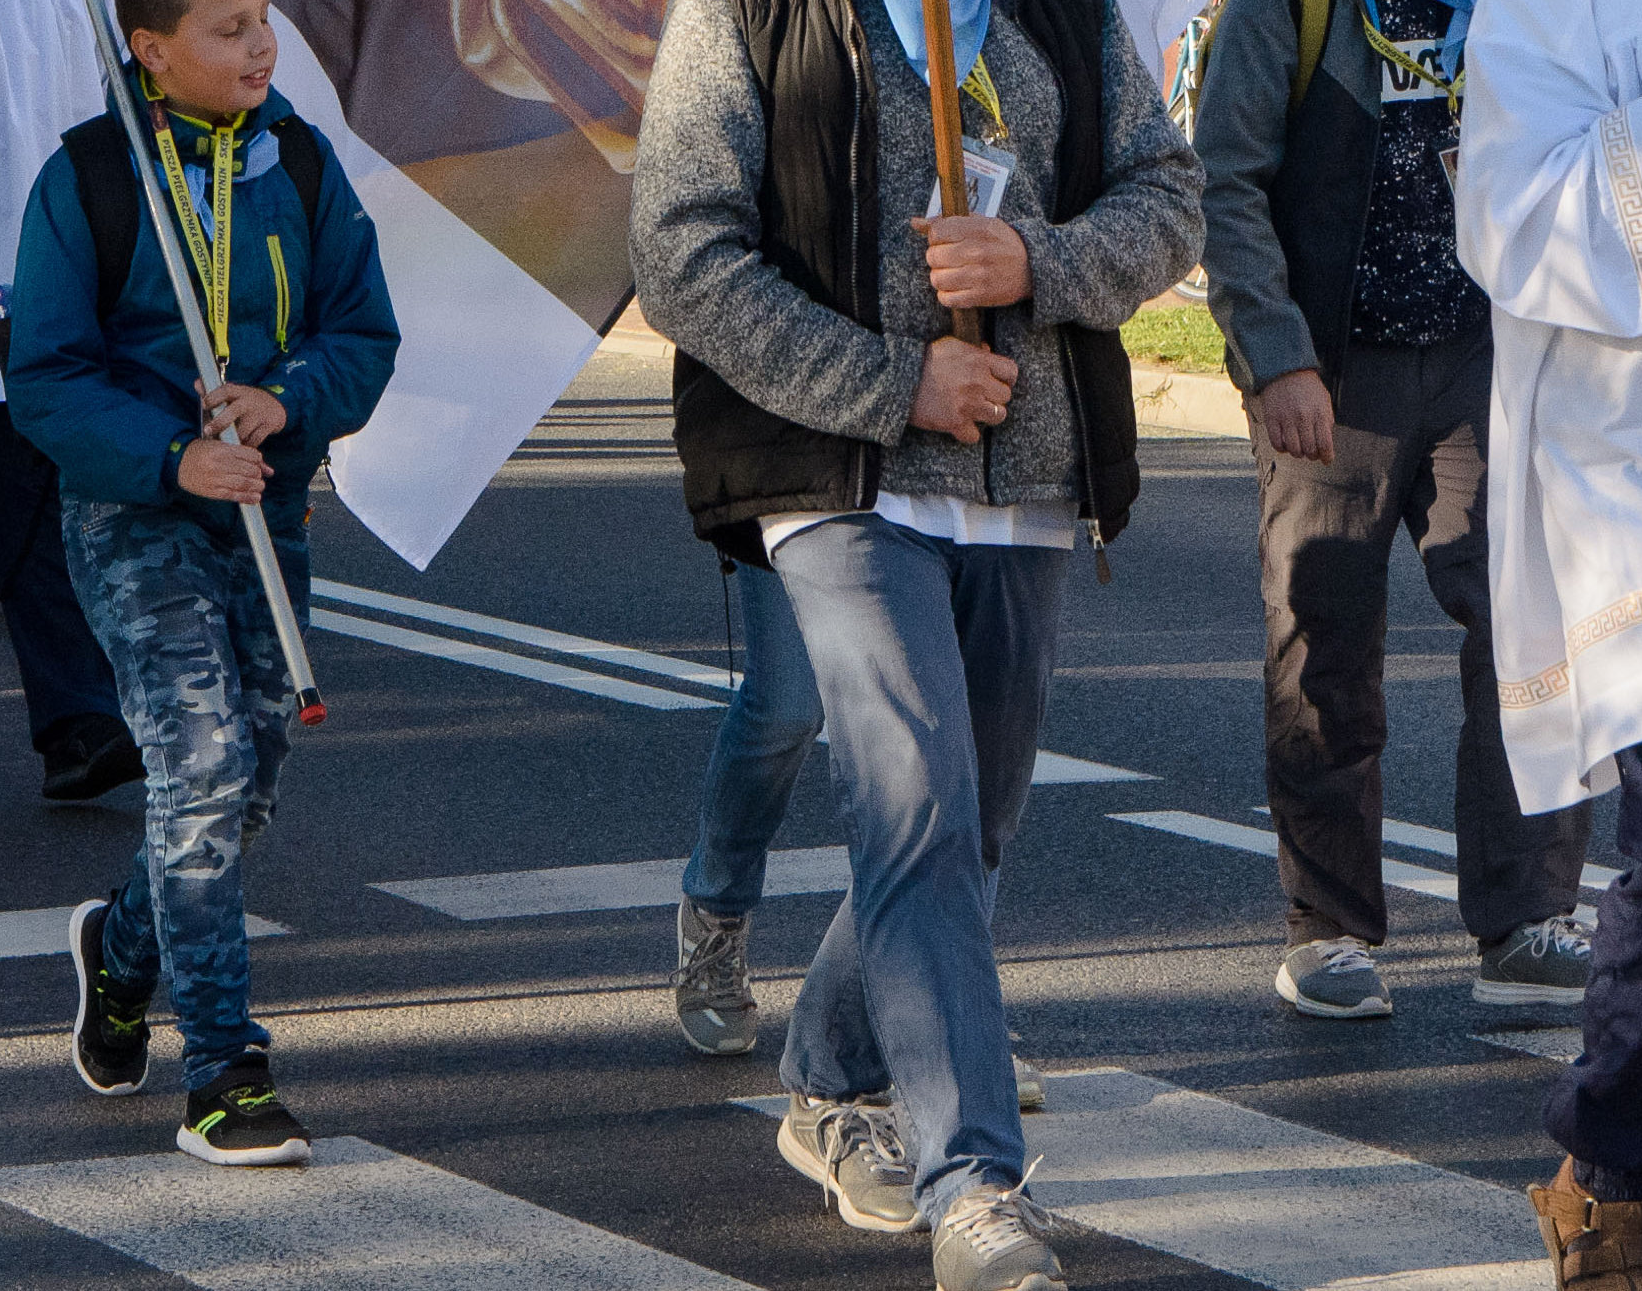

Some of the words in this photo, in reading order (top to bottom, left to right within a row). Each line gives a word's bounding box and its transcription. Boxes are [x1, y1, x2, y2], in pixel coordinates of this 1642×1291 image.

[162, 139, 176, 172] PIESZA
[174, 174, 198, 239] PIELGRZYMKA
[218, 166, 227, 217] GOSTYNIN
[217, 220, 226, 287] PIELGRZYMKA
[217, 290, 225, 324] PIESZA
